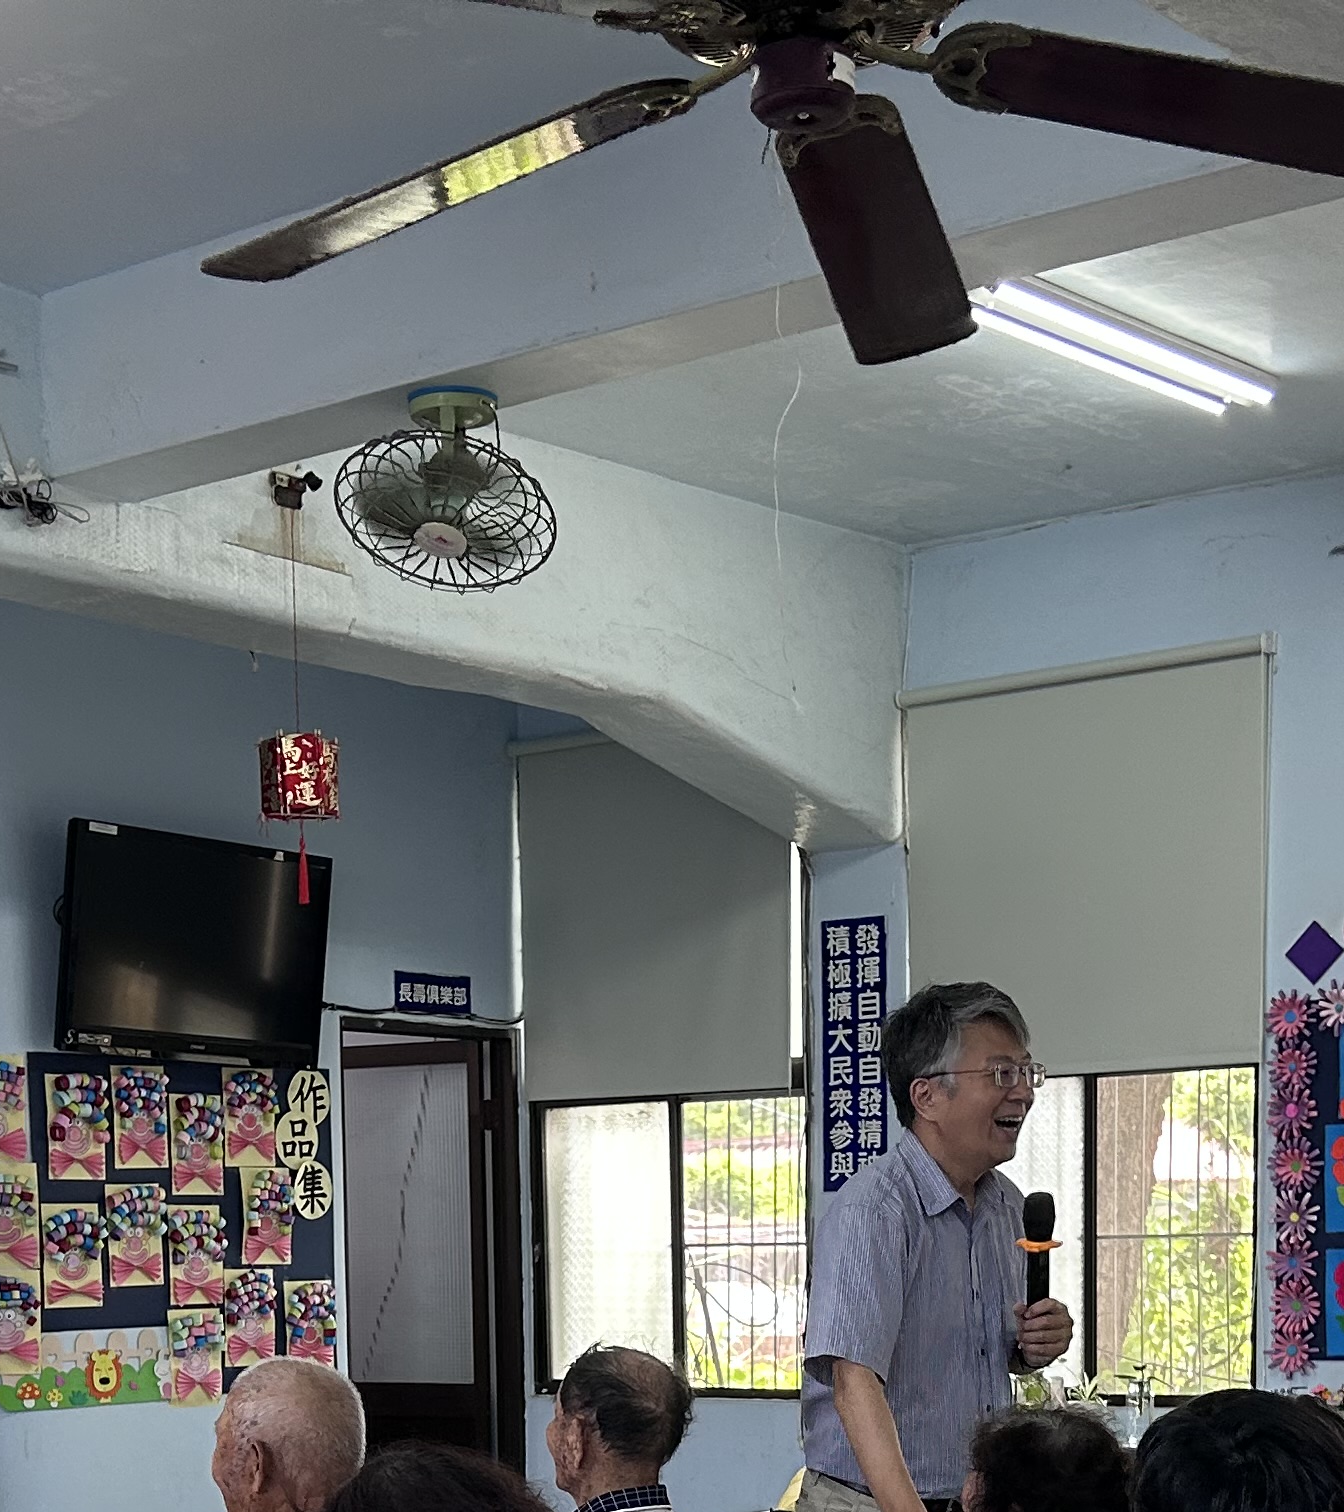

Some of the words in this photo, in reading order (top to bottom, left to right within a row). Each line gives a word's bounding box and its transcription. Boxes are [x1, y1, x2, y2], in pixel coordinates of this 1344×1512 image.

[399, 982, 467, 1006] 長壽俱樂部
[282, 1074, 328, 1214] 作品集
